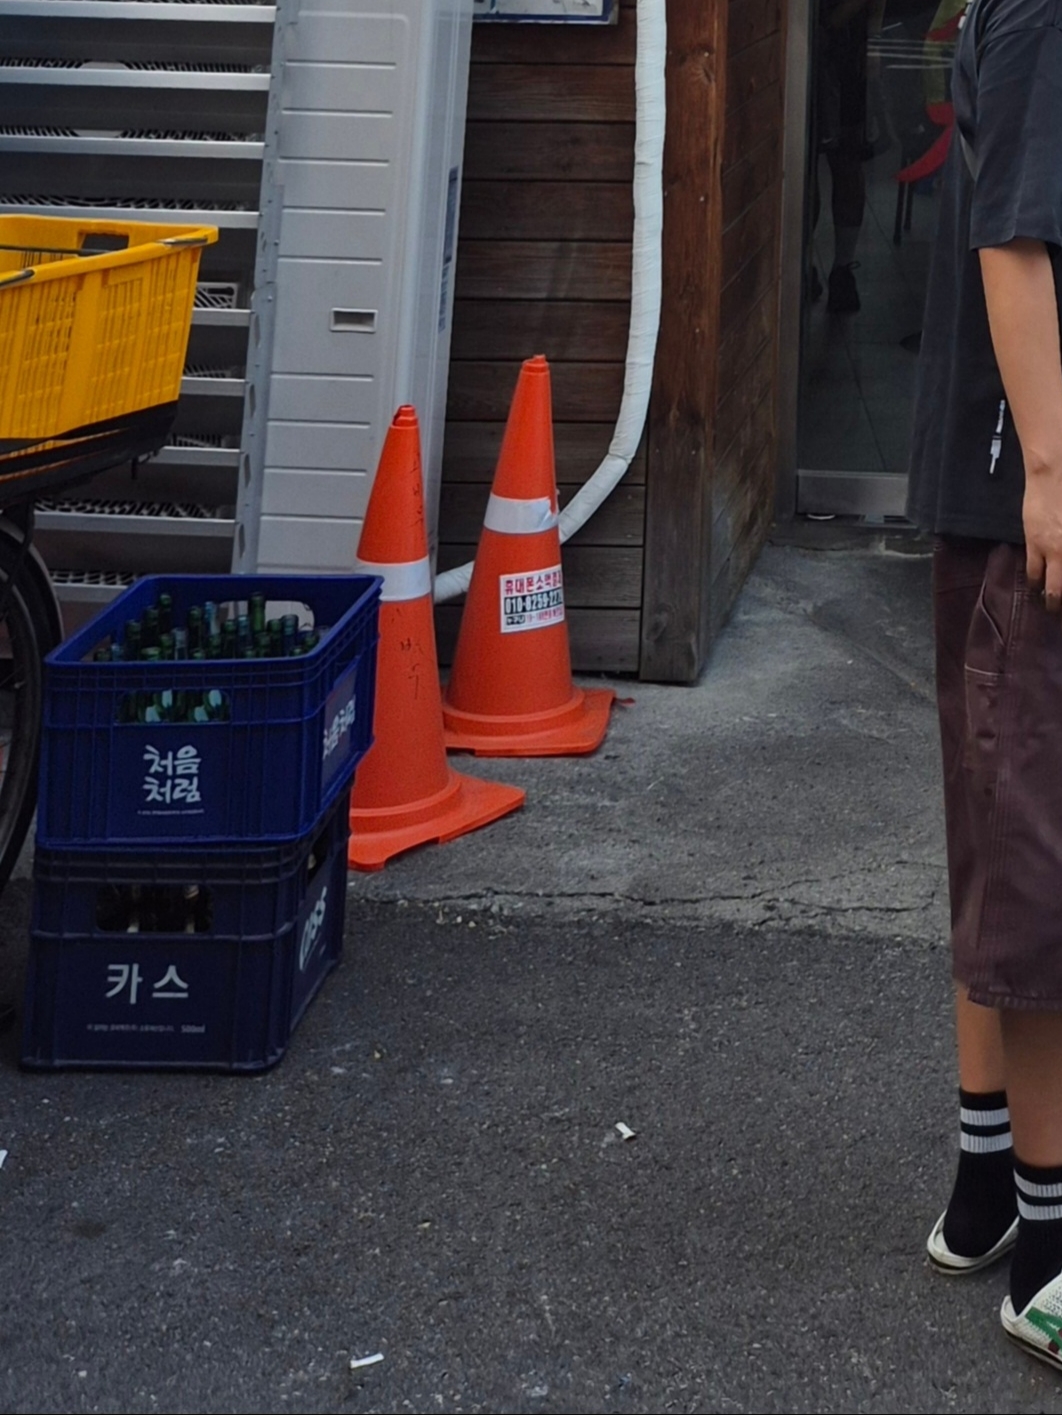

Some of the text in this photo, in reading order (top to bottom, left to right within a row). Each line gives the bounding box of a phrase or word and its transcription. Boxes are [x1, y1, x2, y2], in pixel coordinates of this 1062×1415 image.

[143, 744, 202, 776] 처음
[143, 776, 201, 803] 처럼
[106, 963, 189, 1004] 카스
